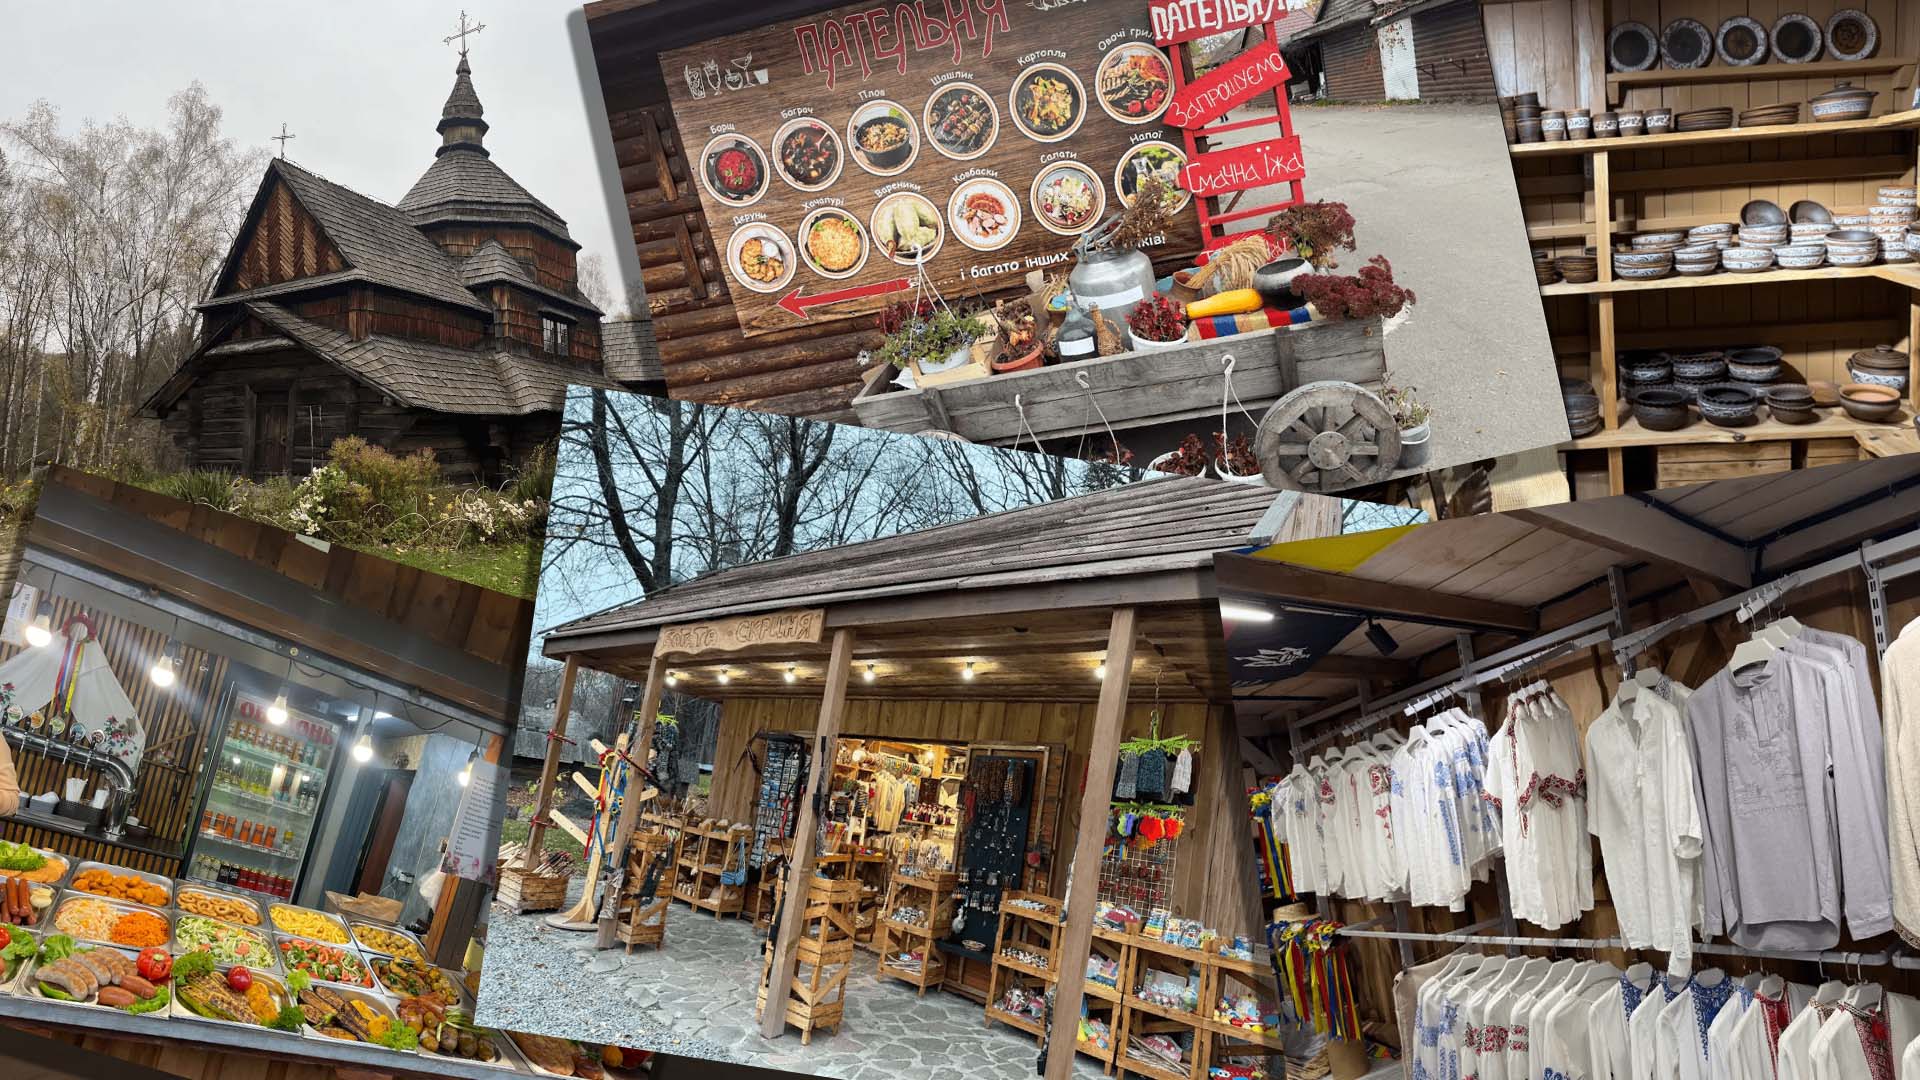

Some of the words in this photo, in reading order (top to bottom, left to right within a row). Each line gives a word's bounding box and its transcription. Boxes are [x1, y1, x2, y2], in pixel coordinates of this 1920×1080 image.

[794, 0, 1010, 90] ПАТЕЛЬНЯ
[1098, 28, 1126, 51] Овочі
[1017, 50, 1067, 66] Картопля
[930, 71, 974, 86] Шашлик
[858, 89, 886, 100] Плов
[781, 106, 814, 119] Бограч
[710, 122, 736, 134] Борщ
[1129, 130, 1163, 144] Напої
[1040, 150, 1077, 164] Салати
[952, 167, 999, 184] Ковбаски
[874, 181, 922, 198] Вареники
[802, 197, 845, 212] Хачапурі
[733, 211, 767, 226] Деруни
[970, 259, 1019, 280] багато
[1025, 252, 1069, 268] інших
